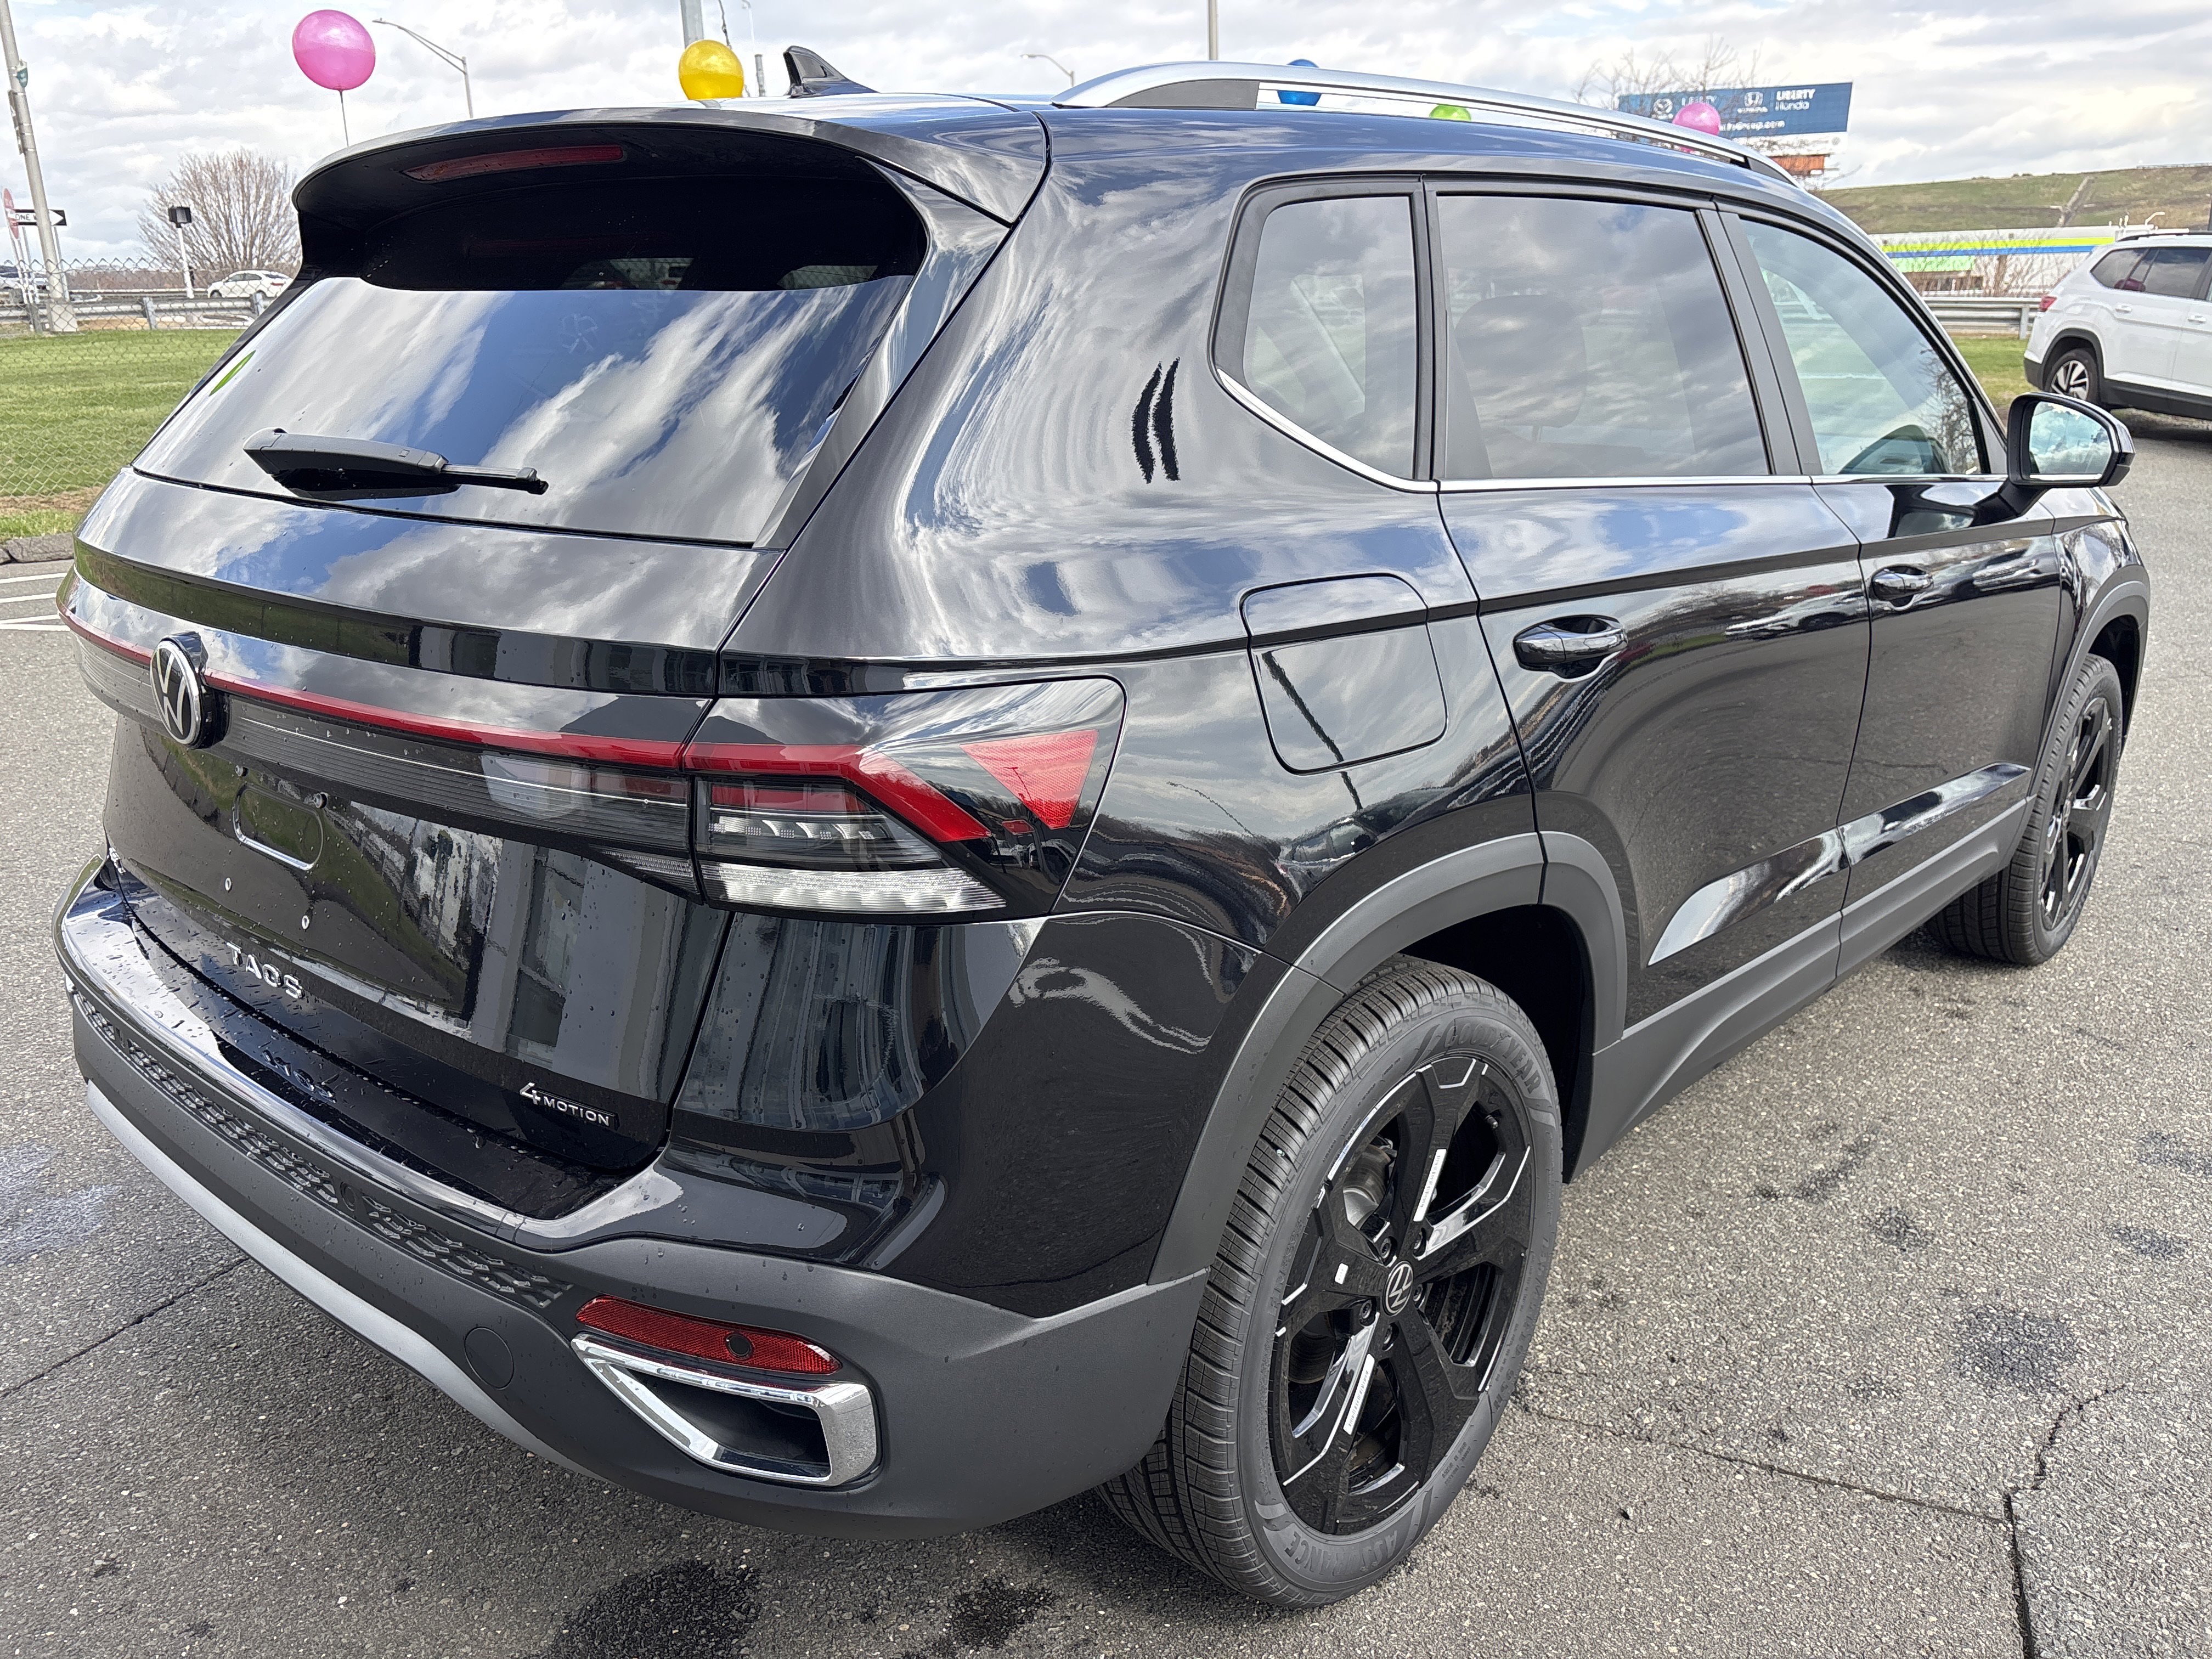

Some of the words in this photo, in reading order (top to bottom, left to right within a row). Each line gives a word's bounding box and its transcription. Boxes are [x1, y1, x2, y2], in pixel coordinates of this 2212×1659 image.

[1775, 100, 1810, 111] Honda
[226, 941, 306, 999] TAOS
[1444, 1023, 1542, 1094] GOODYEAR
[520, 1082, 610, 1126] 4MOTION
